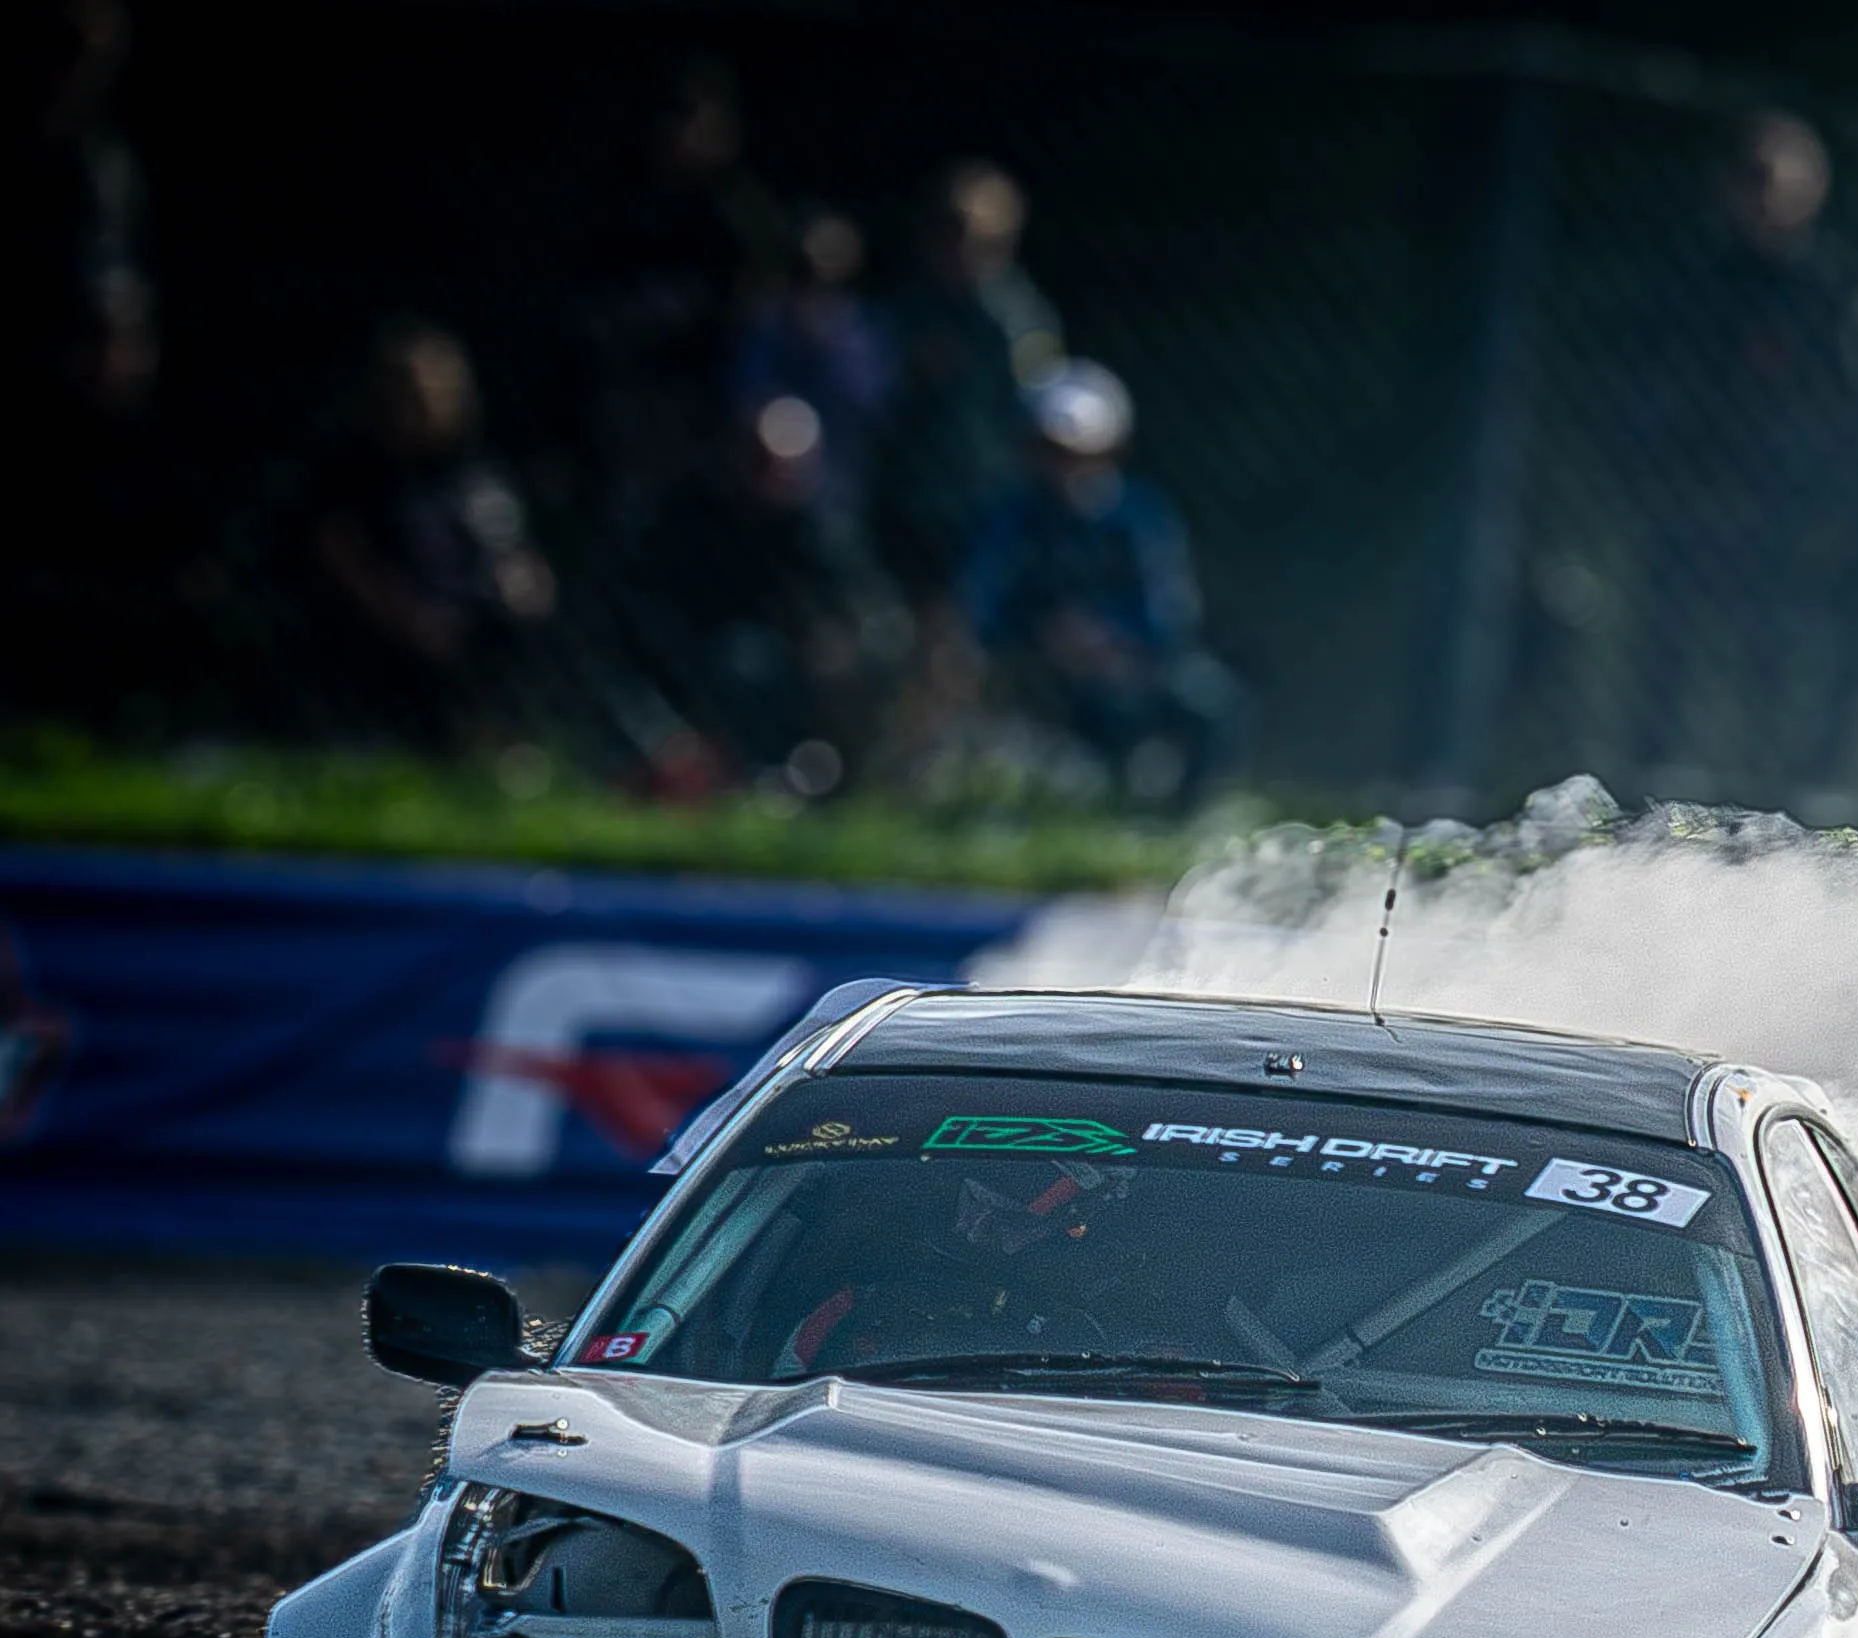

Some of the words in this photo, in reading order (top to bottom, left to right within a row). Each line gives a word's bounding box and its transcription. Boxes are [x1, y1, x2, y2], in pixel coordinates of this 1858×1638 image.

[1142, 1122, 1314, 1155] IRISH
[1319, 1136, 1519, 1177] DRIFT
[1218, 1150, 1492, 1191] SERIES
[1560, 1167, 1672, 1214] 38
